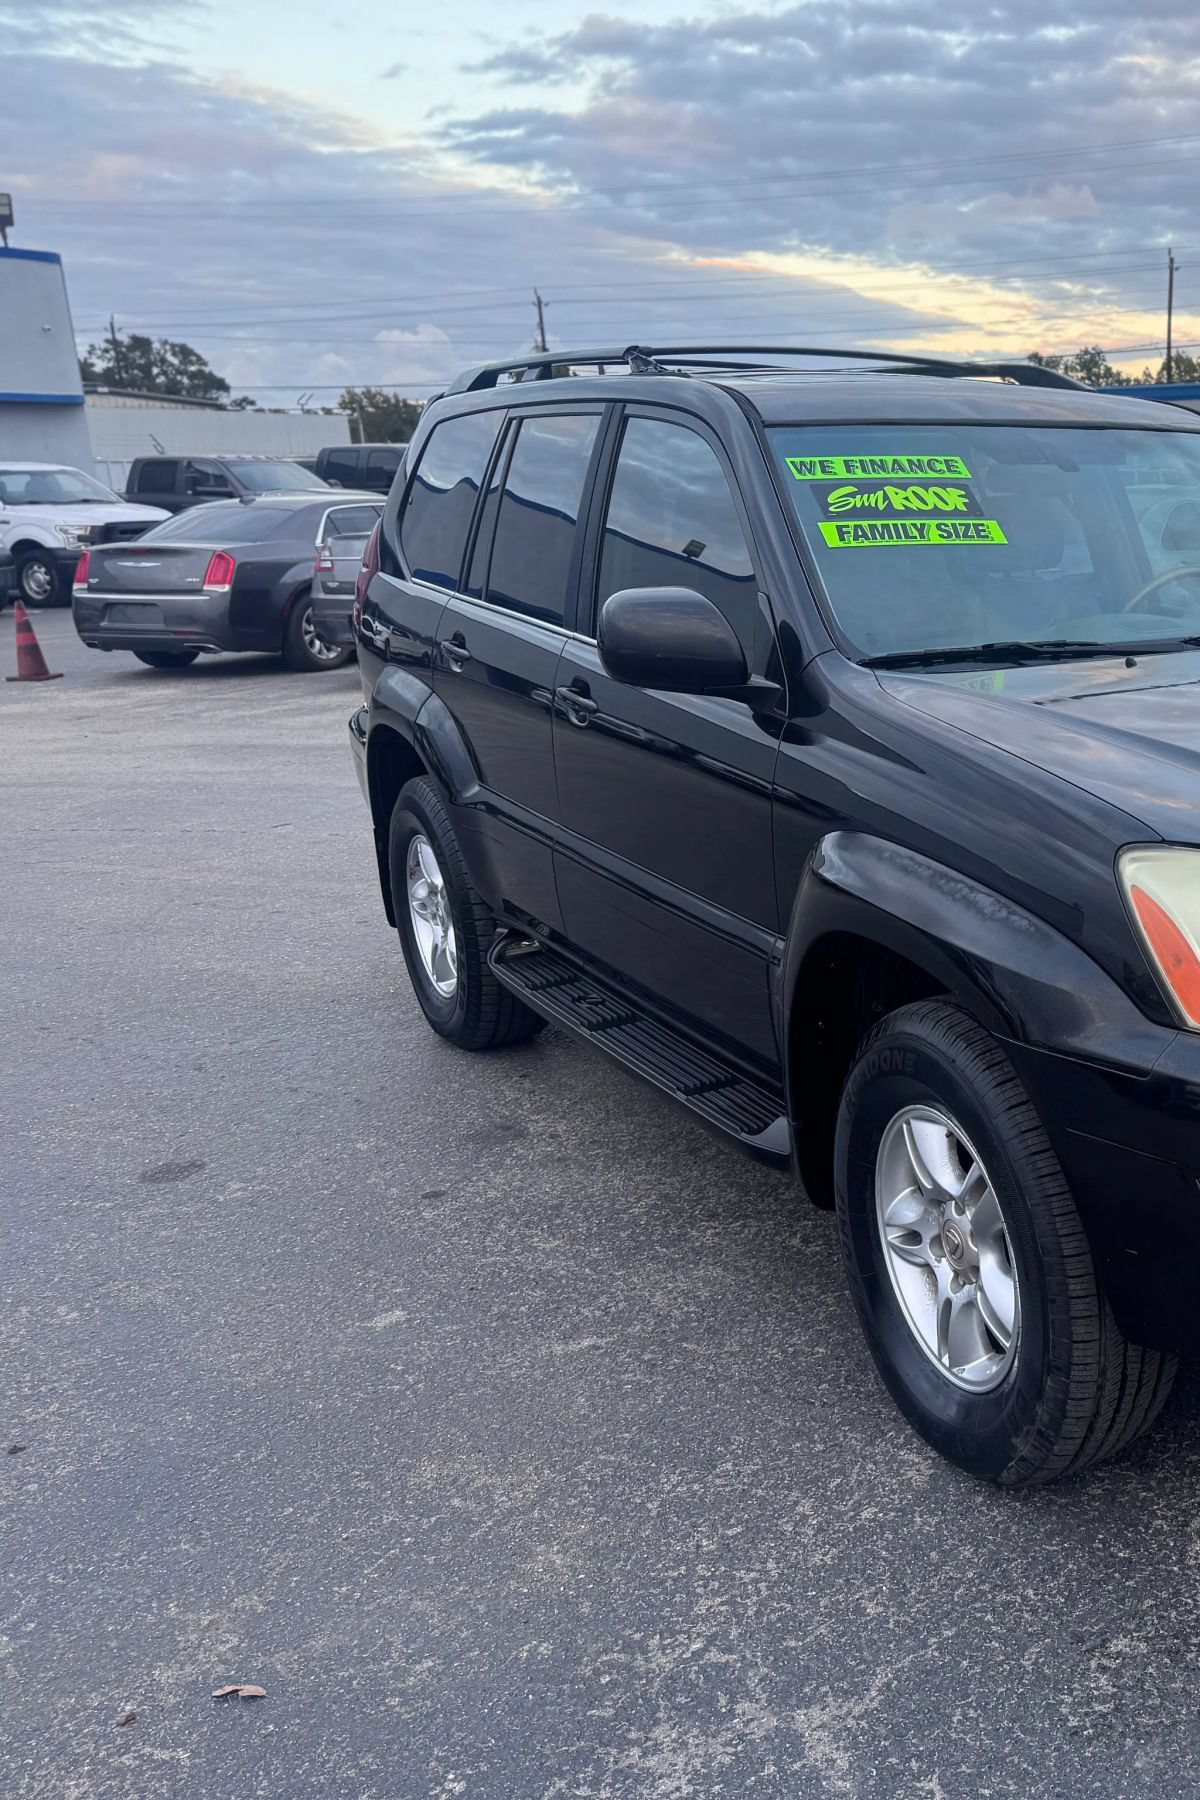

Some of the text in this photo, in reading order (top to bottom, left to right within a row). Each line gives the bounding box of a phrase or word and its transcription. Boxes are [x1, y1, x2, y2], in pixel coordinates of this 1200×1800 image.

[790, 458, 962, 477] WE FINANCE
[827, 485, 970, 512] SunROOF
[835, 522, 994, 542] FAMILY SIZE
